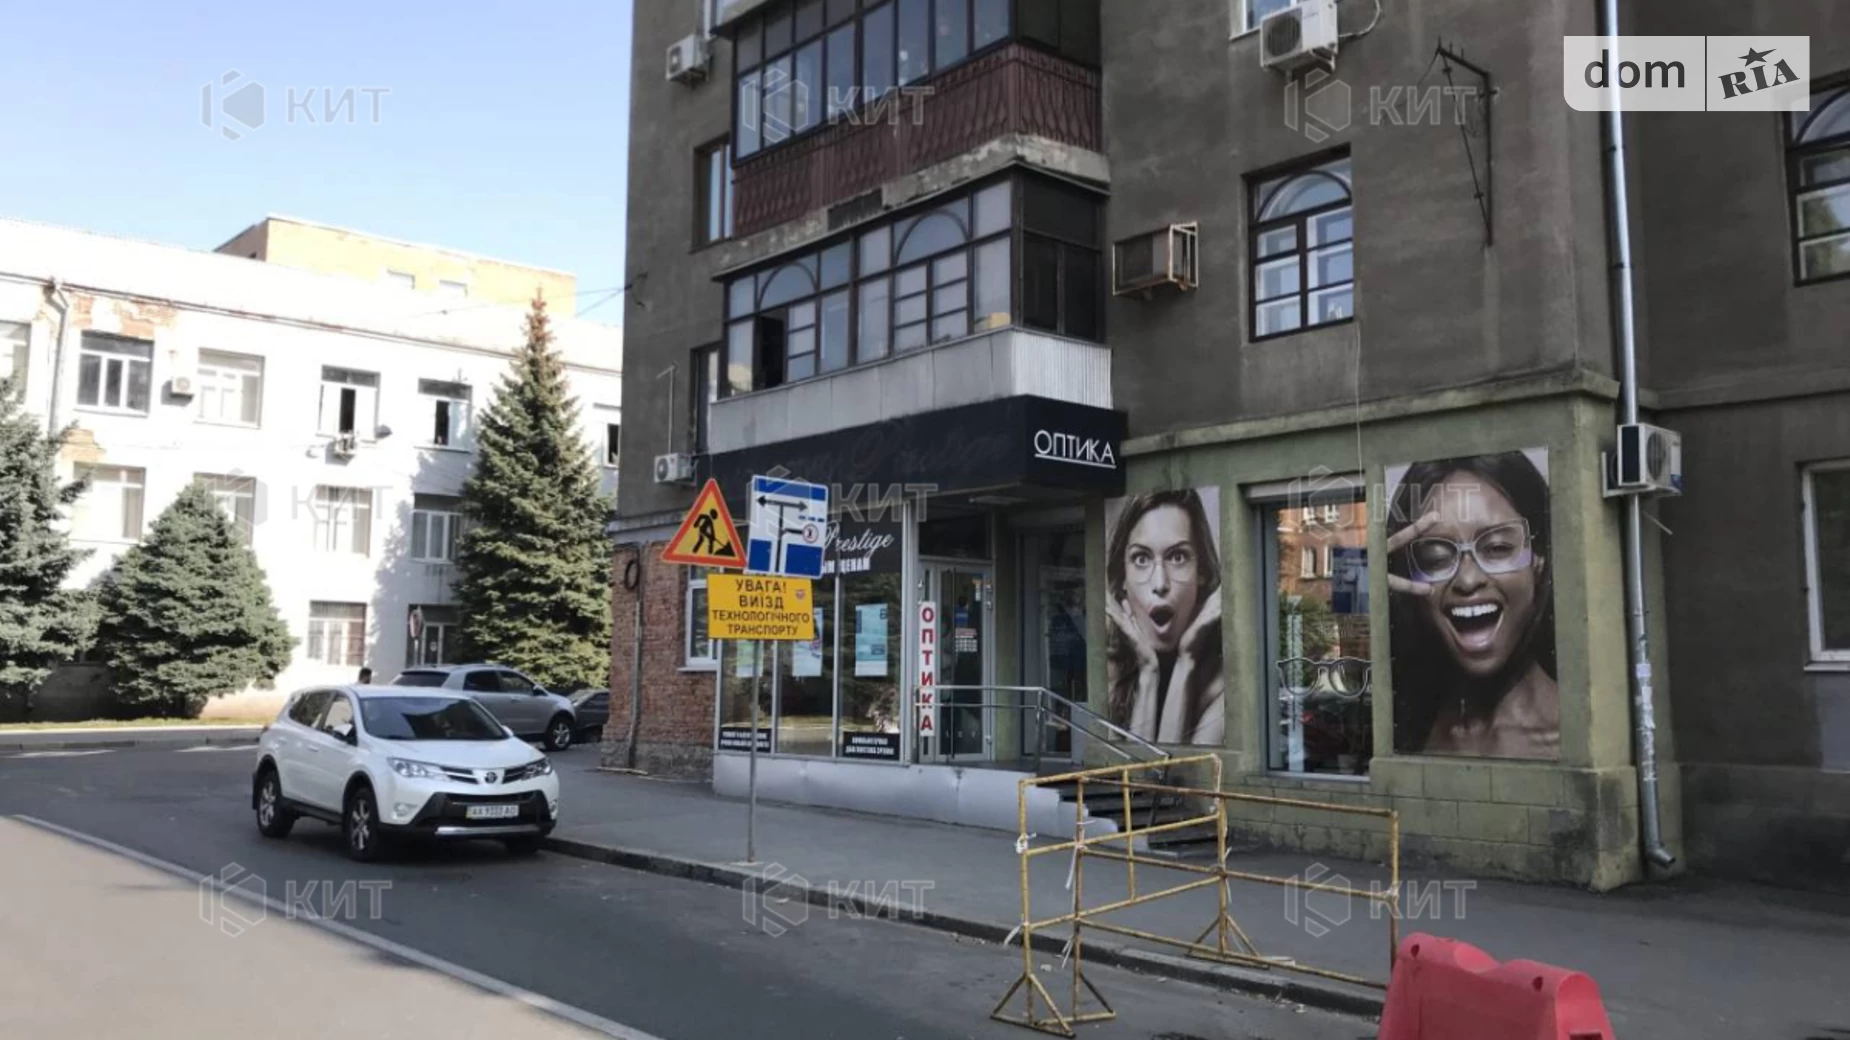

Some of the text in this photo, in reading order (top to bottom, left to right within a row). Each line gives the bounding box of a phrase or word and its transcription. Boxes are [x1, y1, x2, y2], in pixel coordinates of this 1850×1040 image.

[1034, 429, 1116, 465] ОПТИКА
[825, 520, 894, 558] Prestige
[736, 579, 787, 593] УВАГА!
[728, 623, 799, 635] ТРАНСПОРТУ
[921, 607, 934, 731] ОПТИКА
